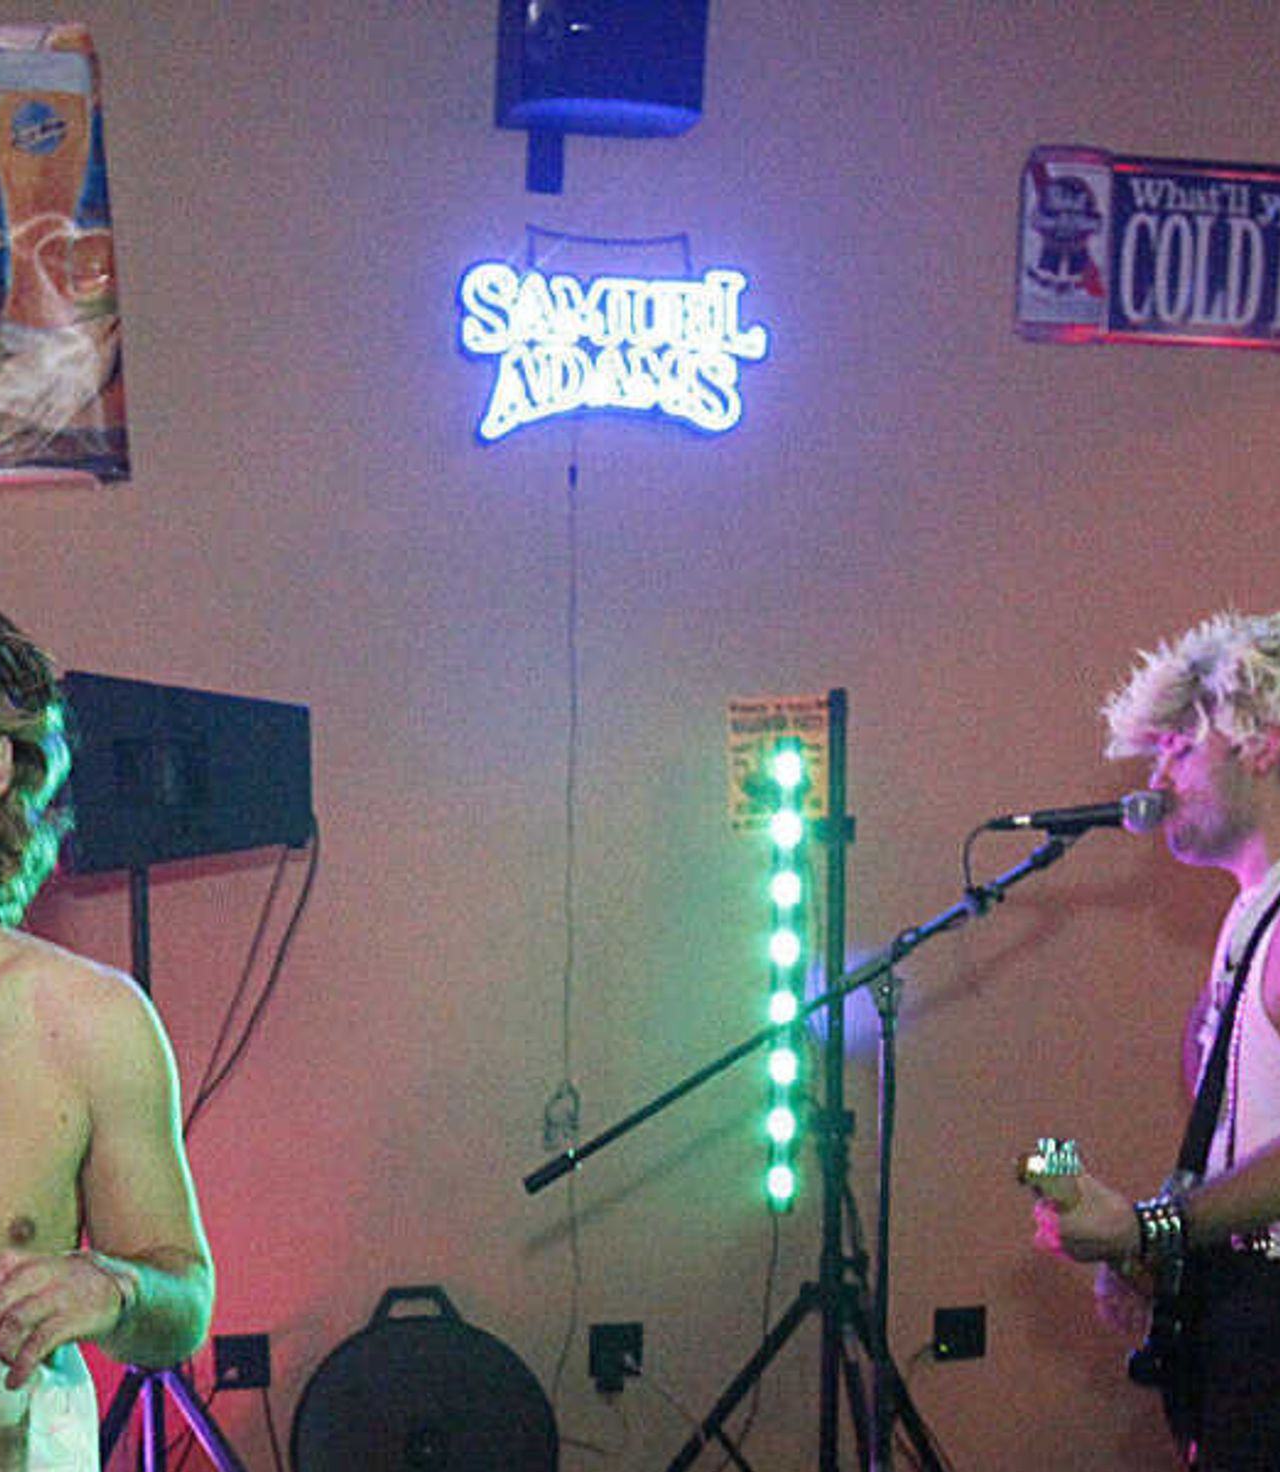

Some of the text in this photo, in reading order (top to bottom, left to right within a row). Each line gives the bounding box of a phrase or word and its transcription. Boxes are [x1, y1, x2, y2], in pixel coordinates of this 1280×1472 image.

[1131, 177, 1251, 217] What'll
[461, 261, 768, 361] SAMUEL
[1121, 211, 1266, 326] COLD
[478, 348, 743, 441] ADAMS
